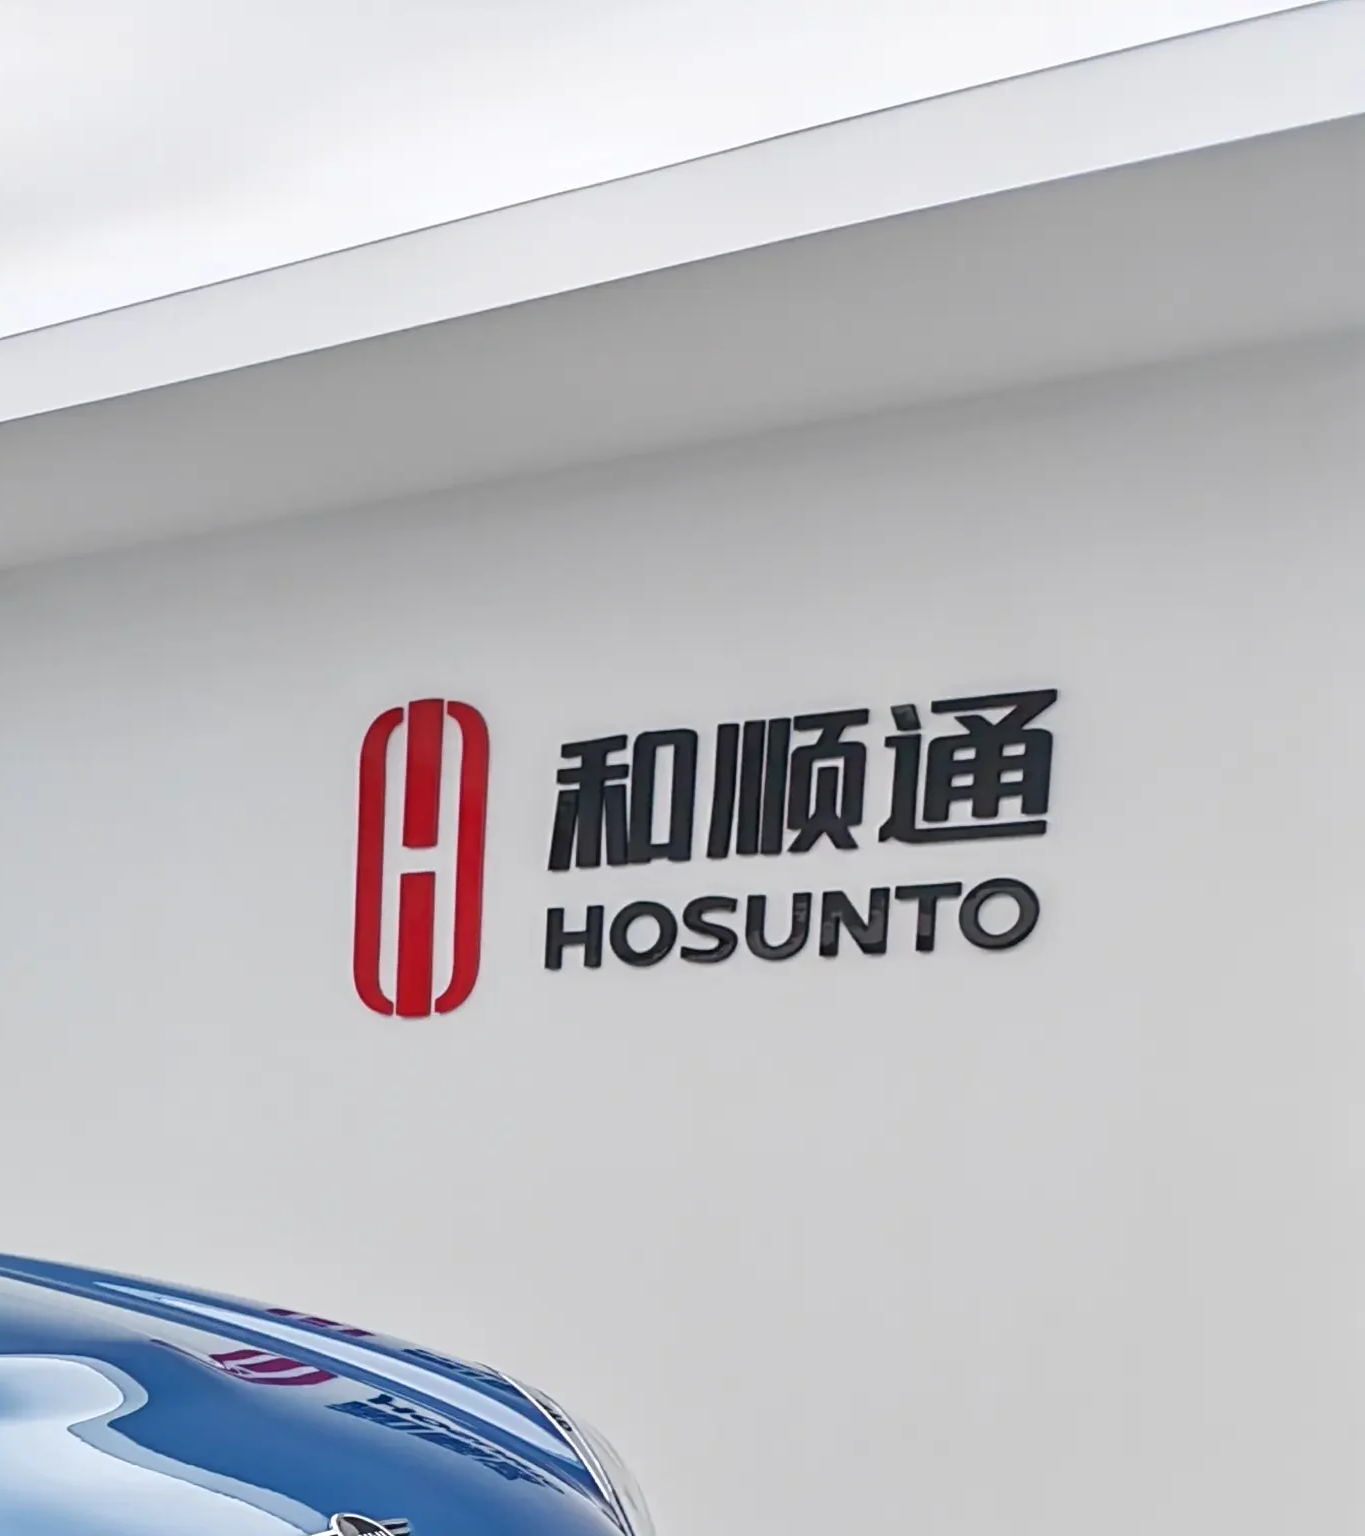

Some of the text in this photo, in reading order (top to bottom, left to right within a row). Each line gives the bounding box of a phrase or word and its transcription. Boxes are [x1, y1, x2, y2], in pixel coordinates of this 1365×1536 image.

[547, 688, 1058, 871] 和顺通
[544, 877, 1041, 970] HOSUNTO
